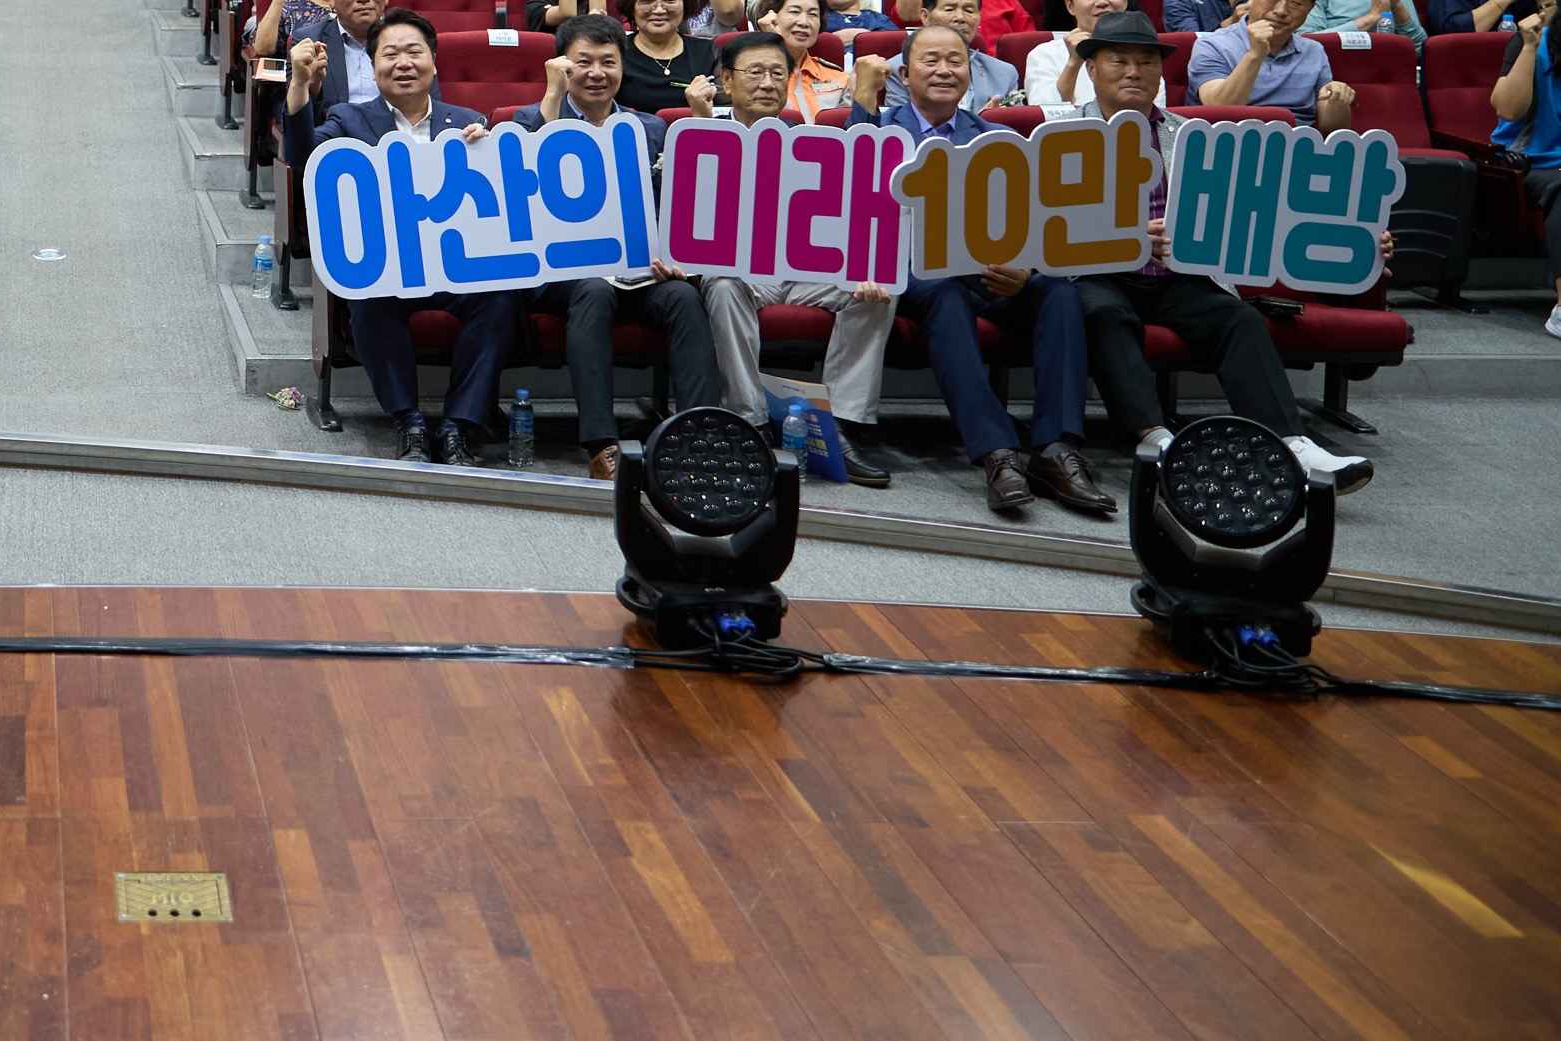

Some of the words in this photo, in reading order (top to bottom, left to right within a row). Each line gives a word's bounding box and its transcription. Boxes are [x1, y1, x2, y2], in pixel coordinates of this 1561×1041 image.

[314, 121, 650, 290] 아산의
[668, 128, 905, 286] 미래
[901, 120, 1153, 272] 10만
[1172, 128, 1396, 286] 배방
